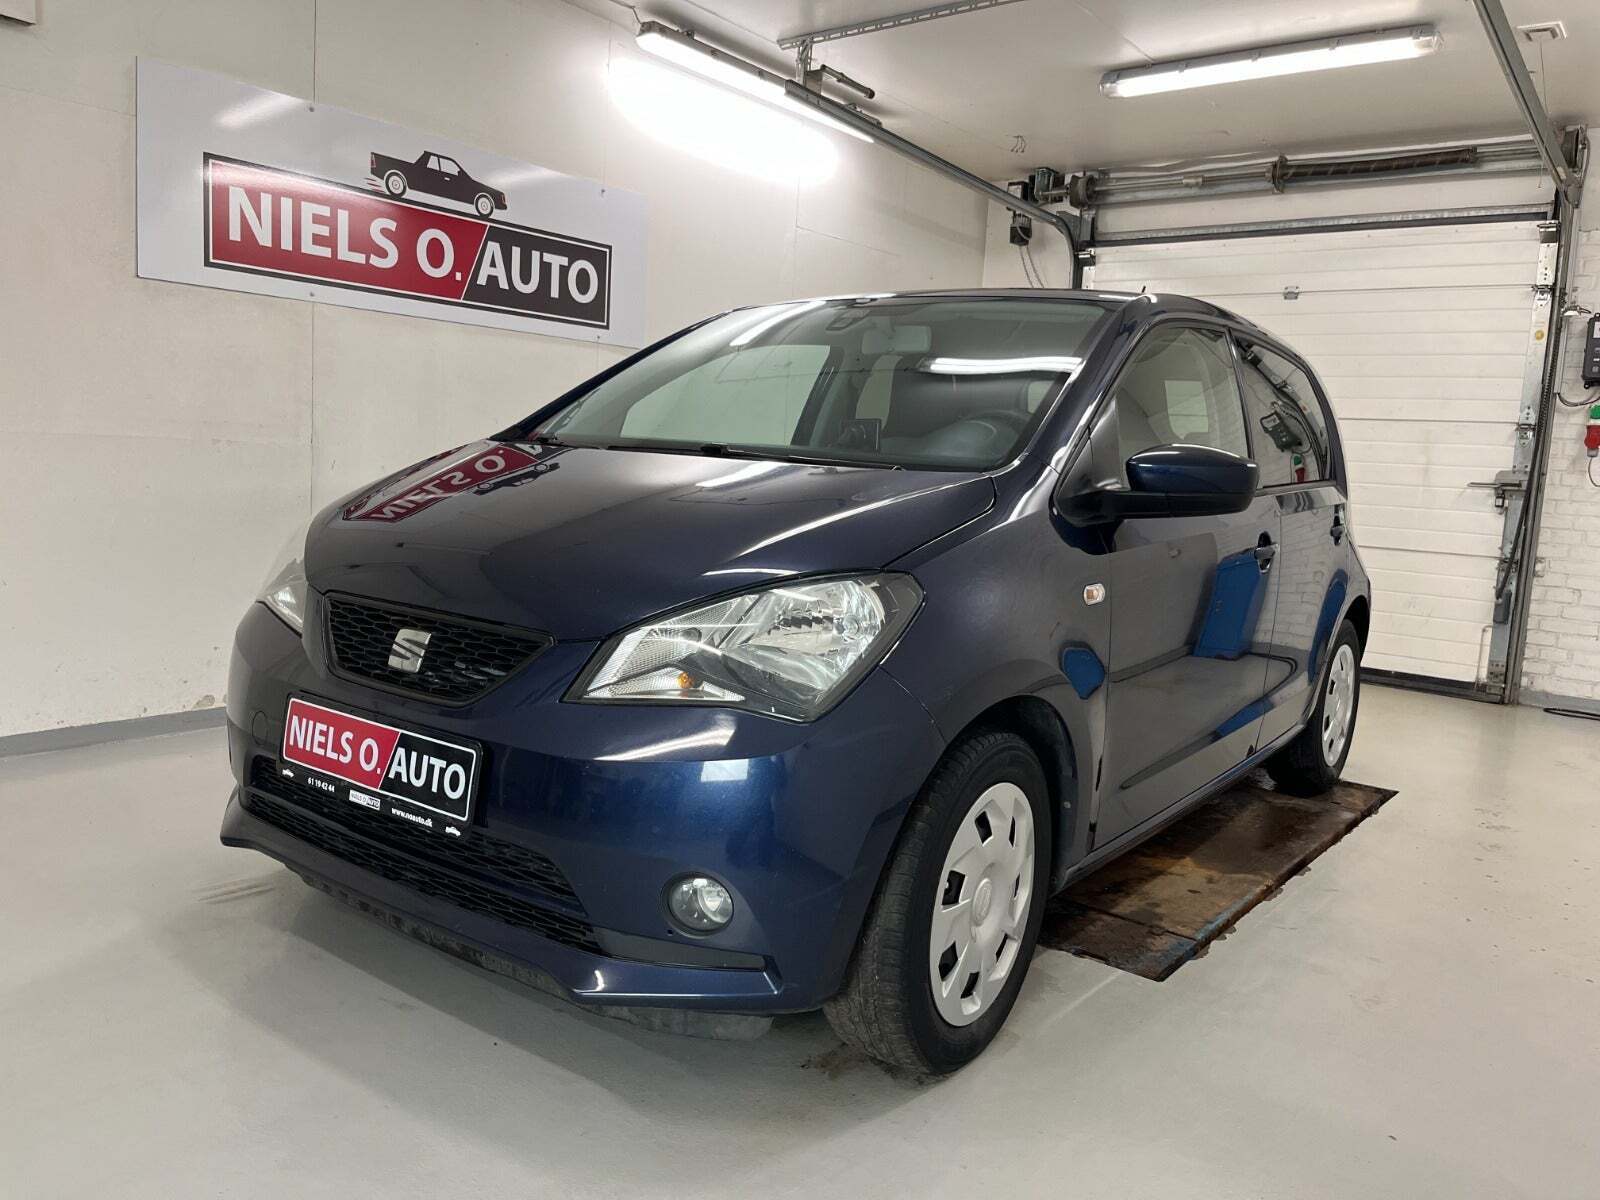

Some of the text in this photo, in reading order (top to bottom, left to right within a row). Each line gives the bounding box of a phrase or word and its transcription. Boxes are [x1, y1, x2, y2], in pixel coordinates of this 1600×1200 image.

[228, 187, 599, 303] NIELS O. AUTO
[289, 715, 466, 799] NIELS O. AUTO
[391, 807, 433, 828] www.noauto.dk
